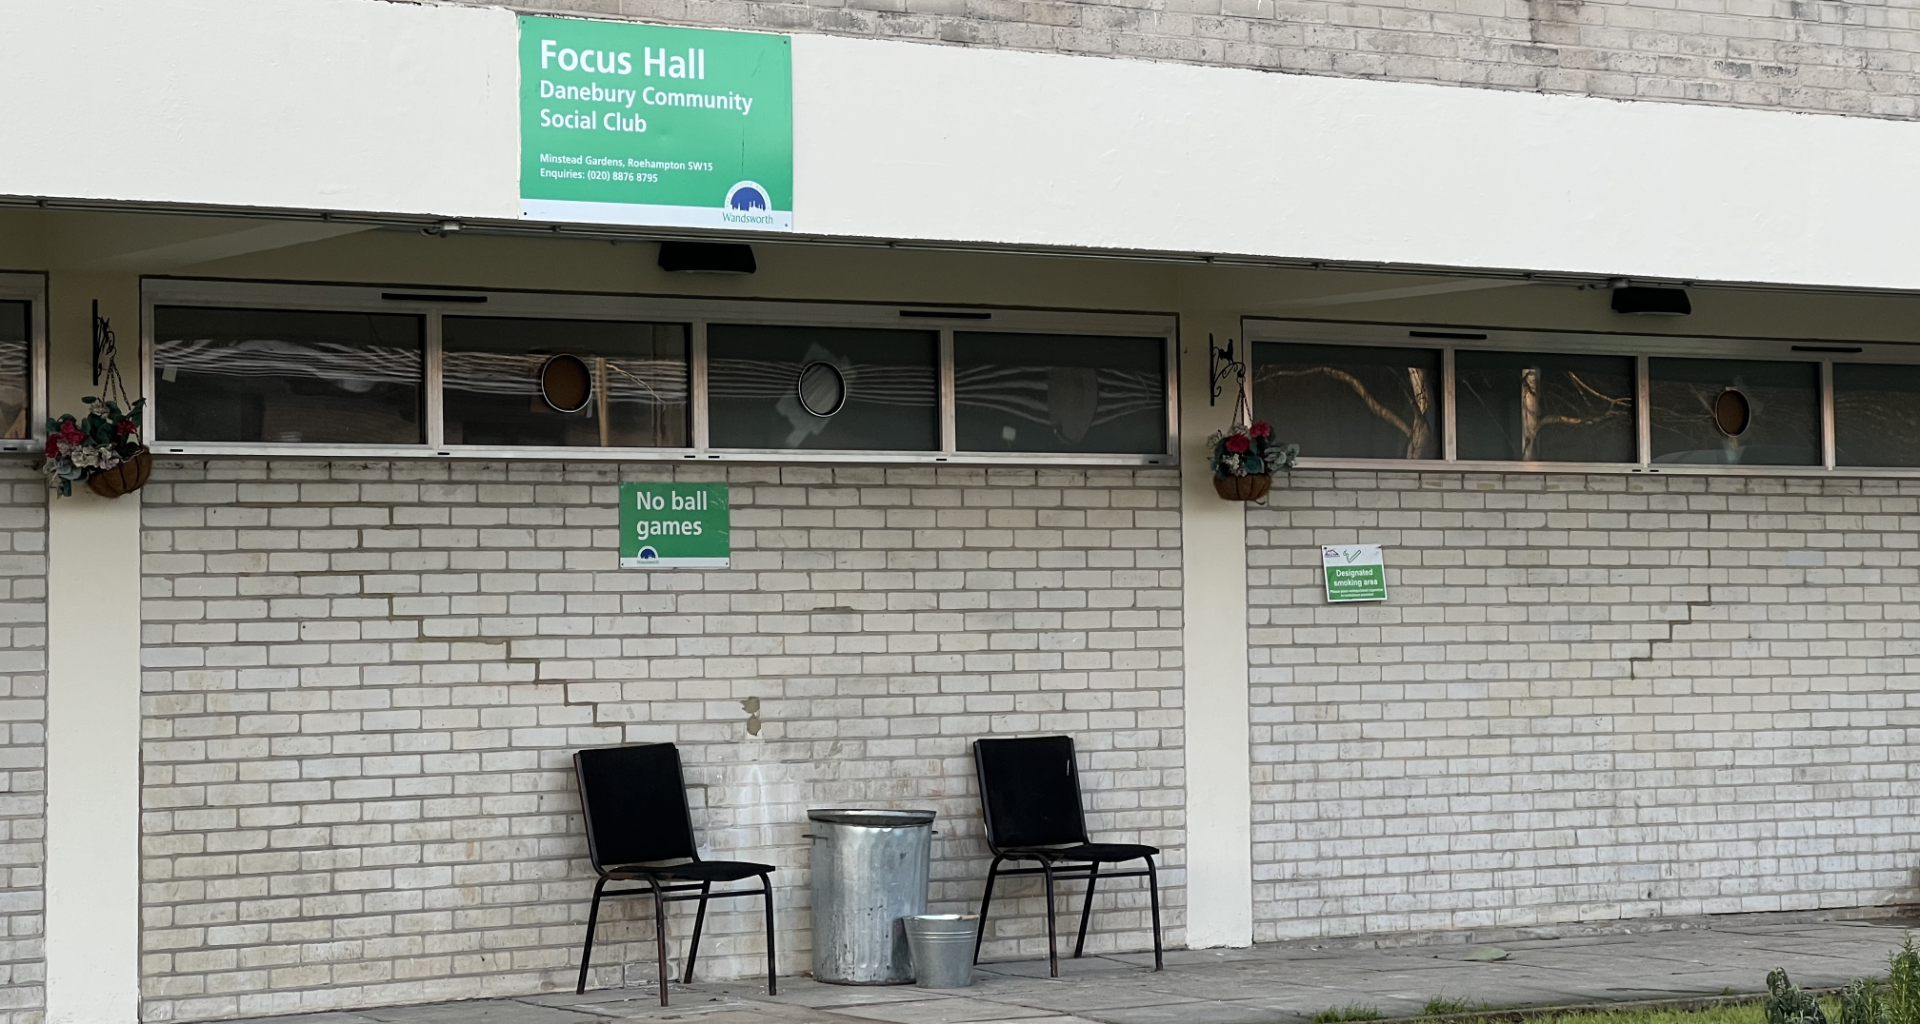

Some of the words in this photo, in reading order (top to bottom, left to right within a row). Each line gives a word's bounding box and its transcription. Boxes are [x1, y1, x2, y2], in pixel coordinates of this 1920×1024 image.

[541, 39, 632, 75] Focus
[644, 47, 705, 80] Hall
[540, 80, 636, 108] Danebury
[642, 87, 753, 115] Community
[540, 109, 596, 130] Social
[603, 112, 647, 133] Club
[540, 154, 582, 165] Minstead
[585, 156, 625, 168] Gardens,
[628, 158, 685, 171] Roehampton
[688, 161, 713, 171] SW15
[540, 168, 585, 180] Enquiries:
[587, 170, 610, 182] (020)
[612, 172, 634, 182] 8876
[636, 173, 658, 183] 8795
[722, 212, 774, 225] Wandsworth
[636, 491, 665, 511] No
[671, 490, 708, 511] ball
[636, 520, 703, 541] games
[1336, 568, 1373, 578] Designated
[1333, 579, 1363, 588] smoking
